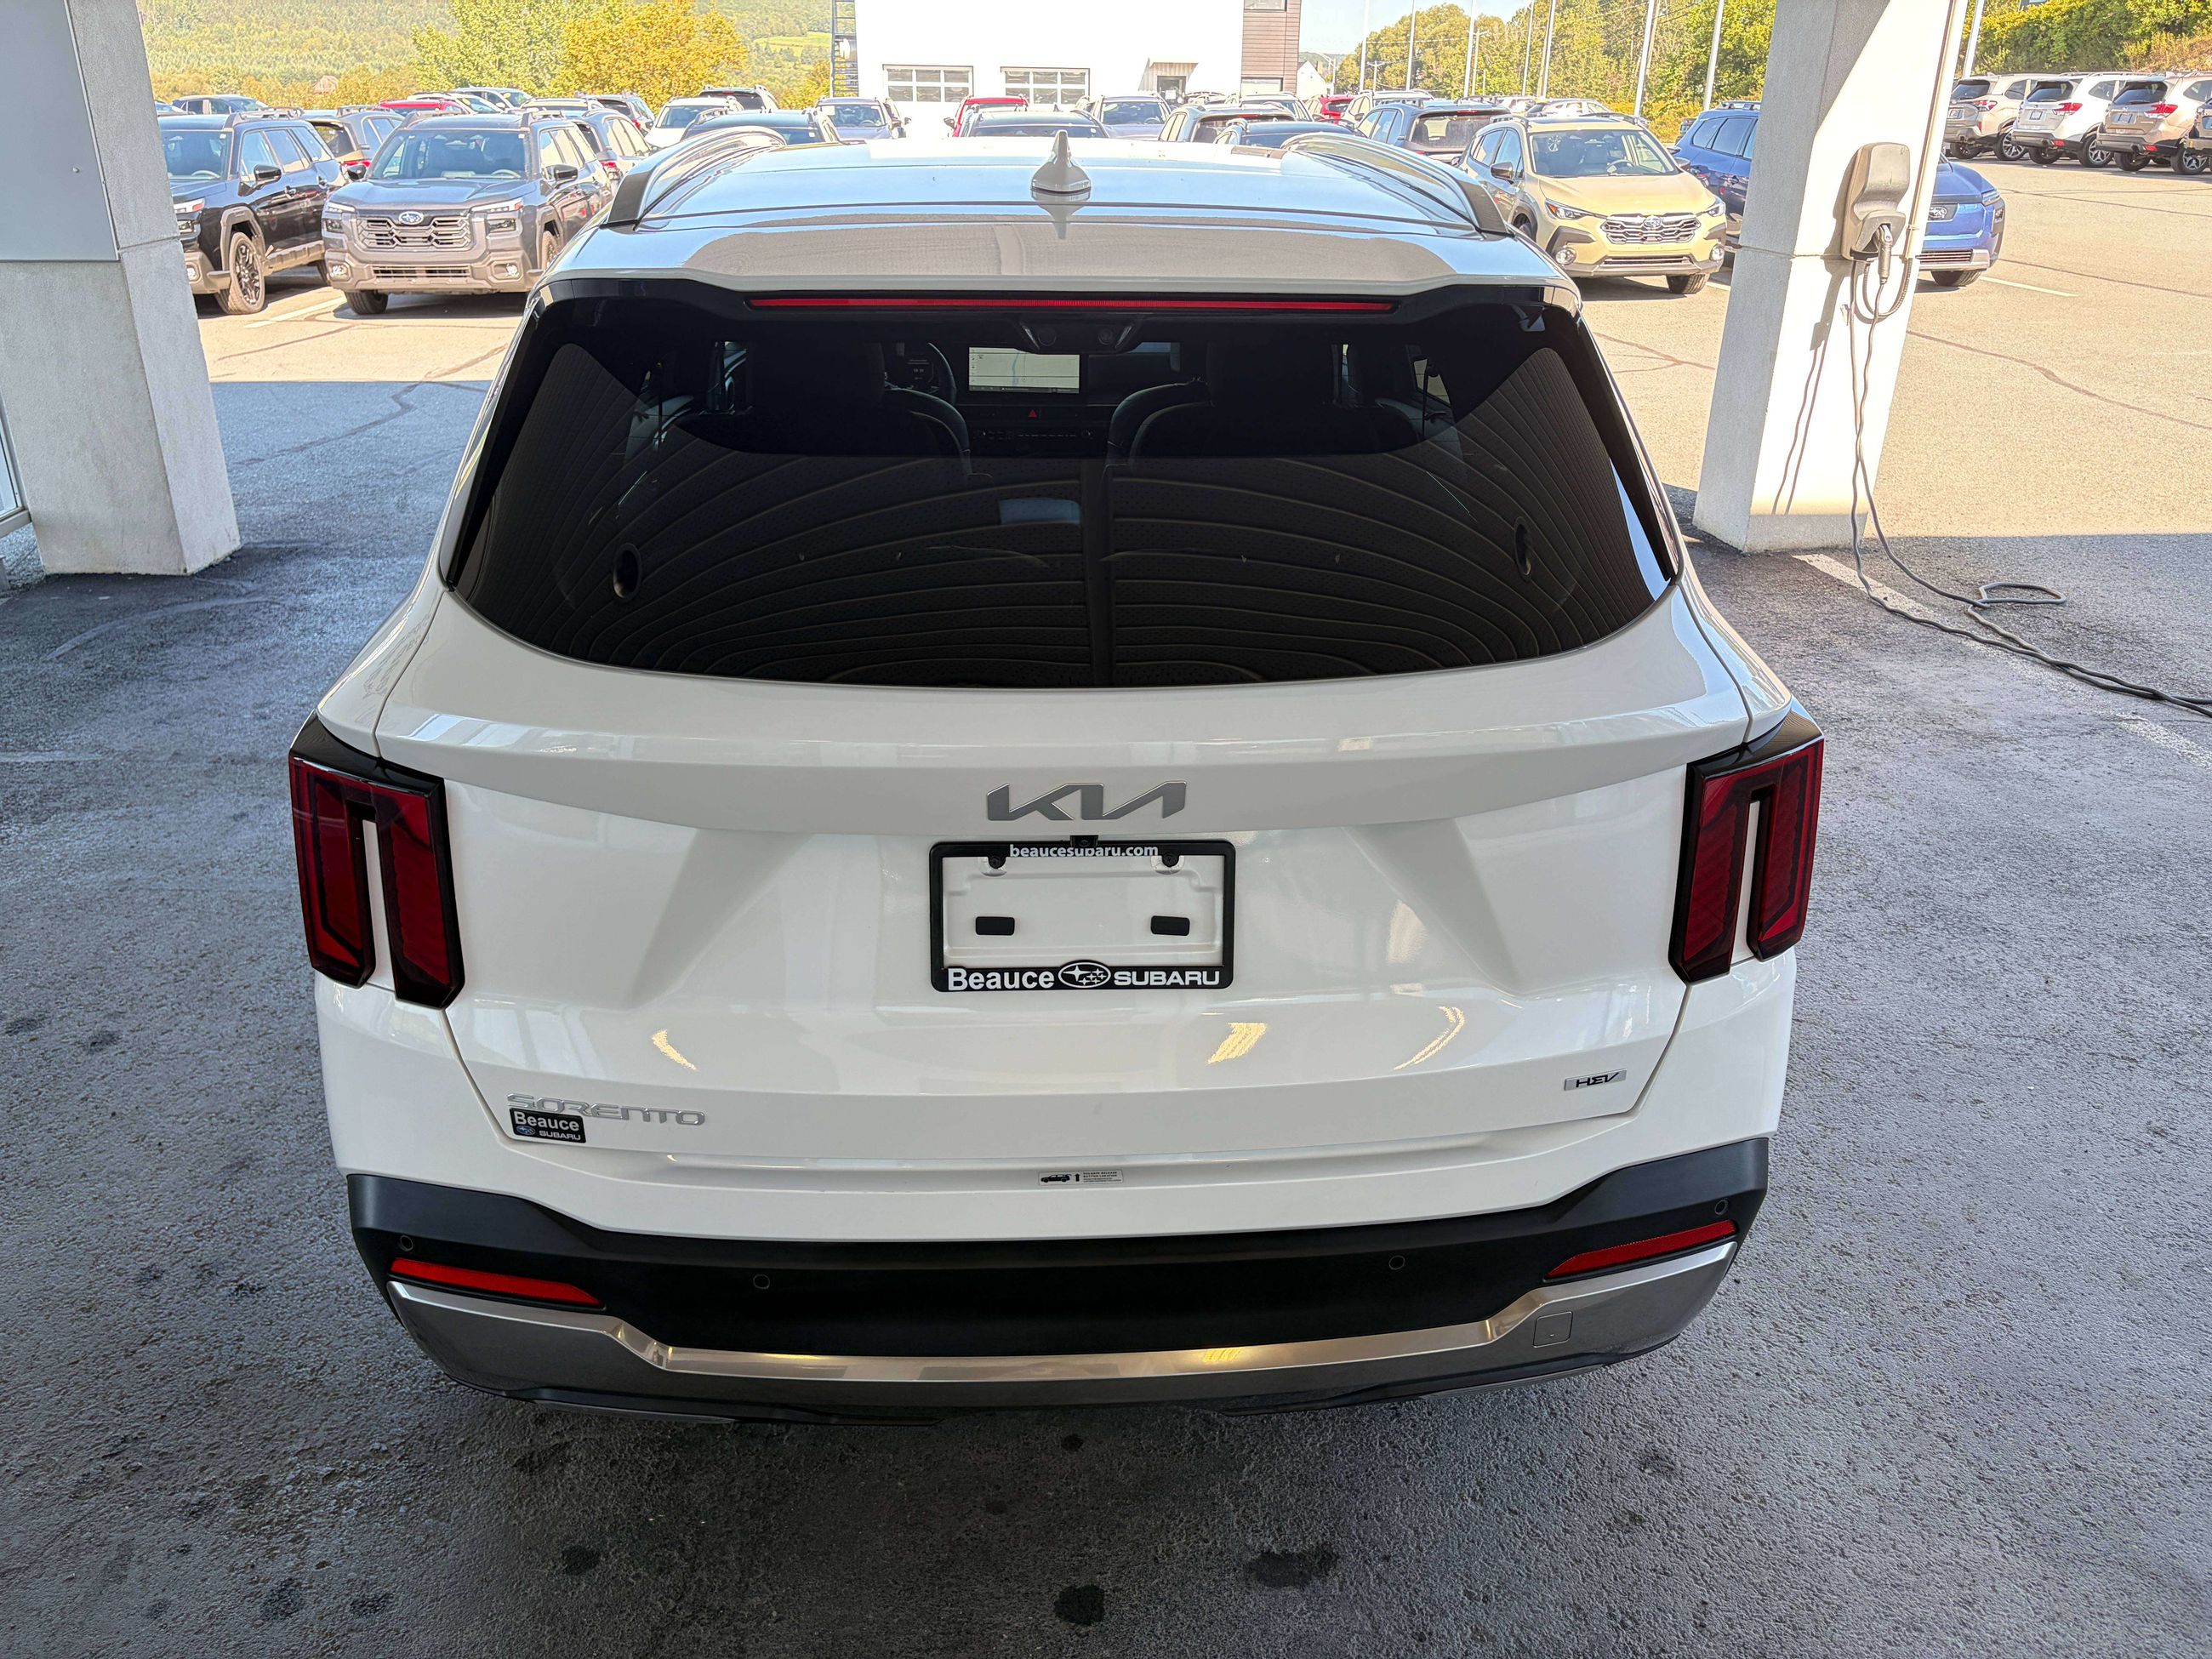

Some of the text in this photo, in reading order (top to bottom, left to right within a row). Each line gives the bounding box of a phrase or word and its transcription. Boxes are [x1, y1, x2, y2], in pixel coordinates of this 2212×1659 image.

[986, 780, 1187, 821] KIA
[1009, 843, 1160, 858] beaucesubaru.com
[947, 967, 1220, 990] Beauce SUBARU
[1576, 1071, 1620, 1088] HEV
[507, 1092, 705, 1126] SORENTO
[513, 1110, 580, 1132] Beauce
[539, 1129, 581, 1141] SUBARU
